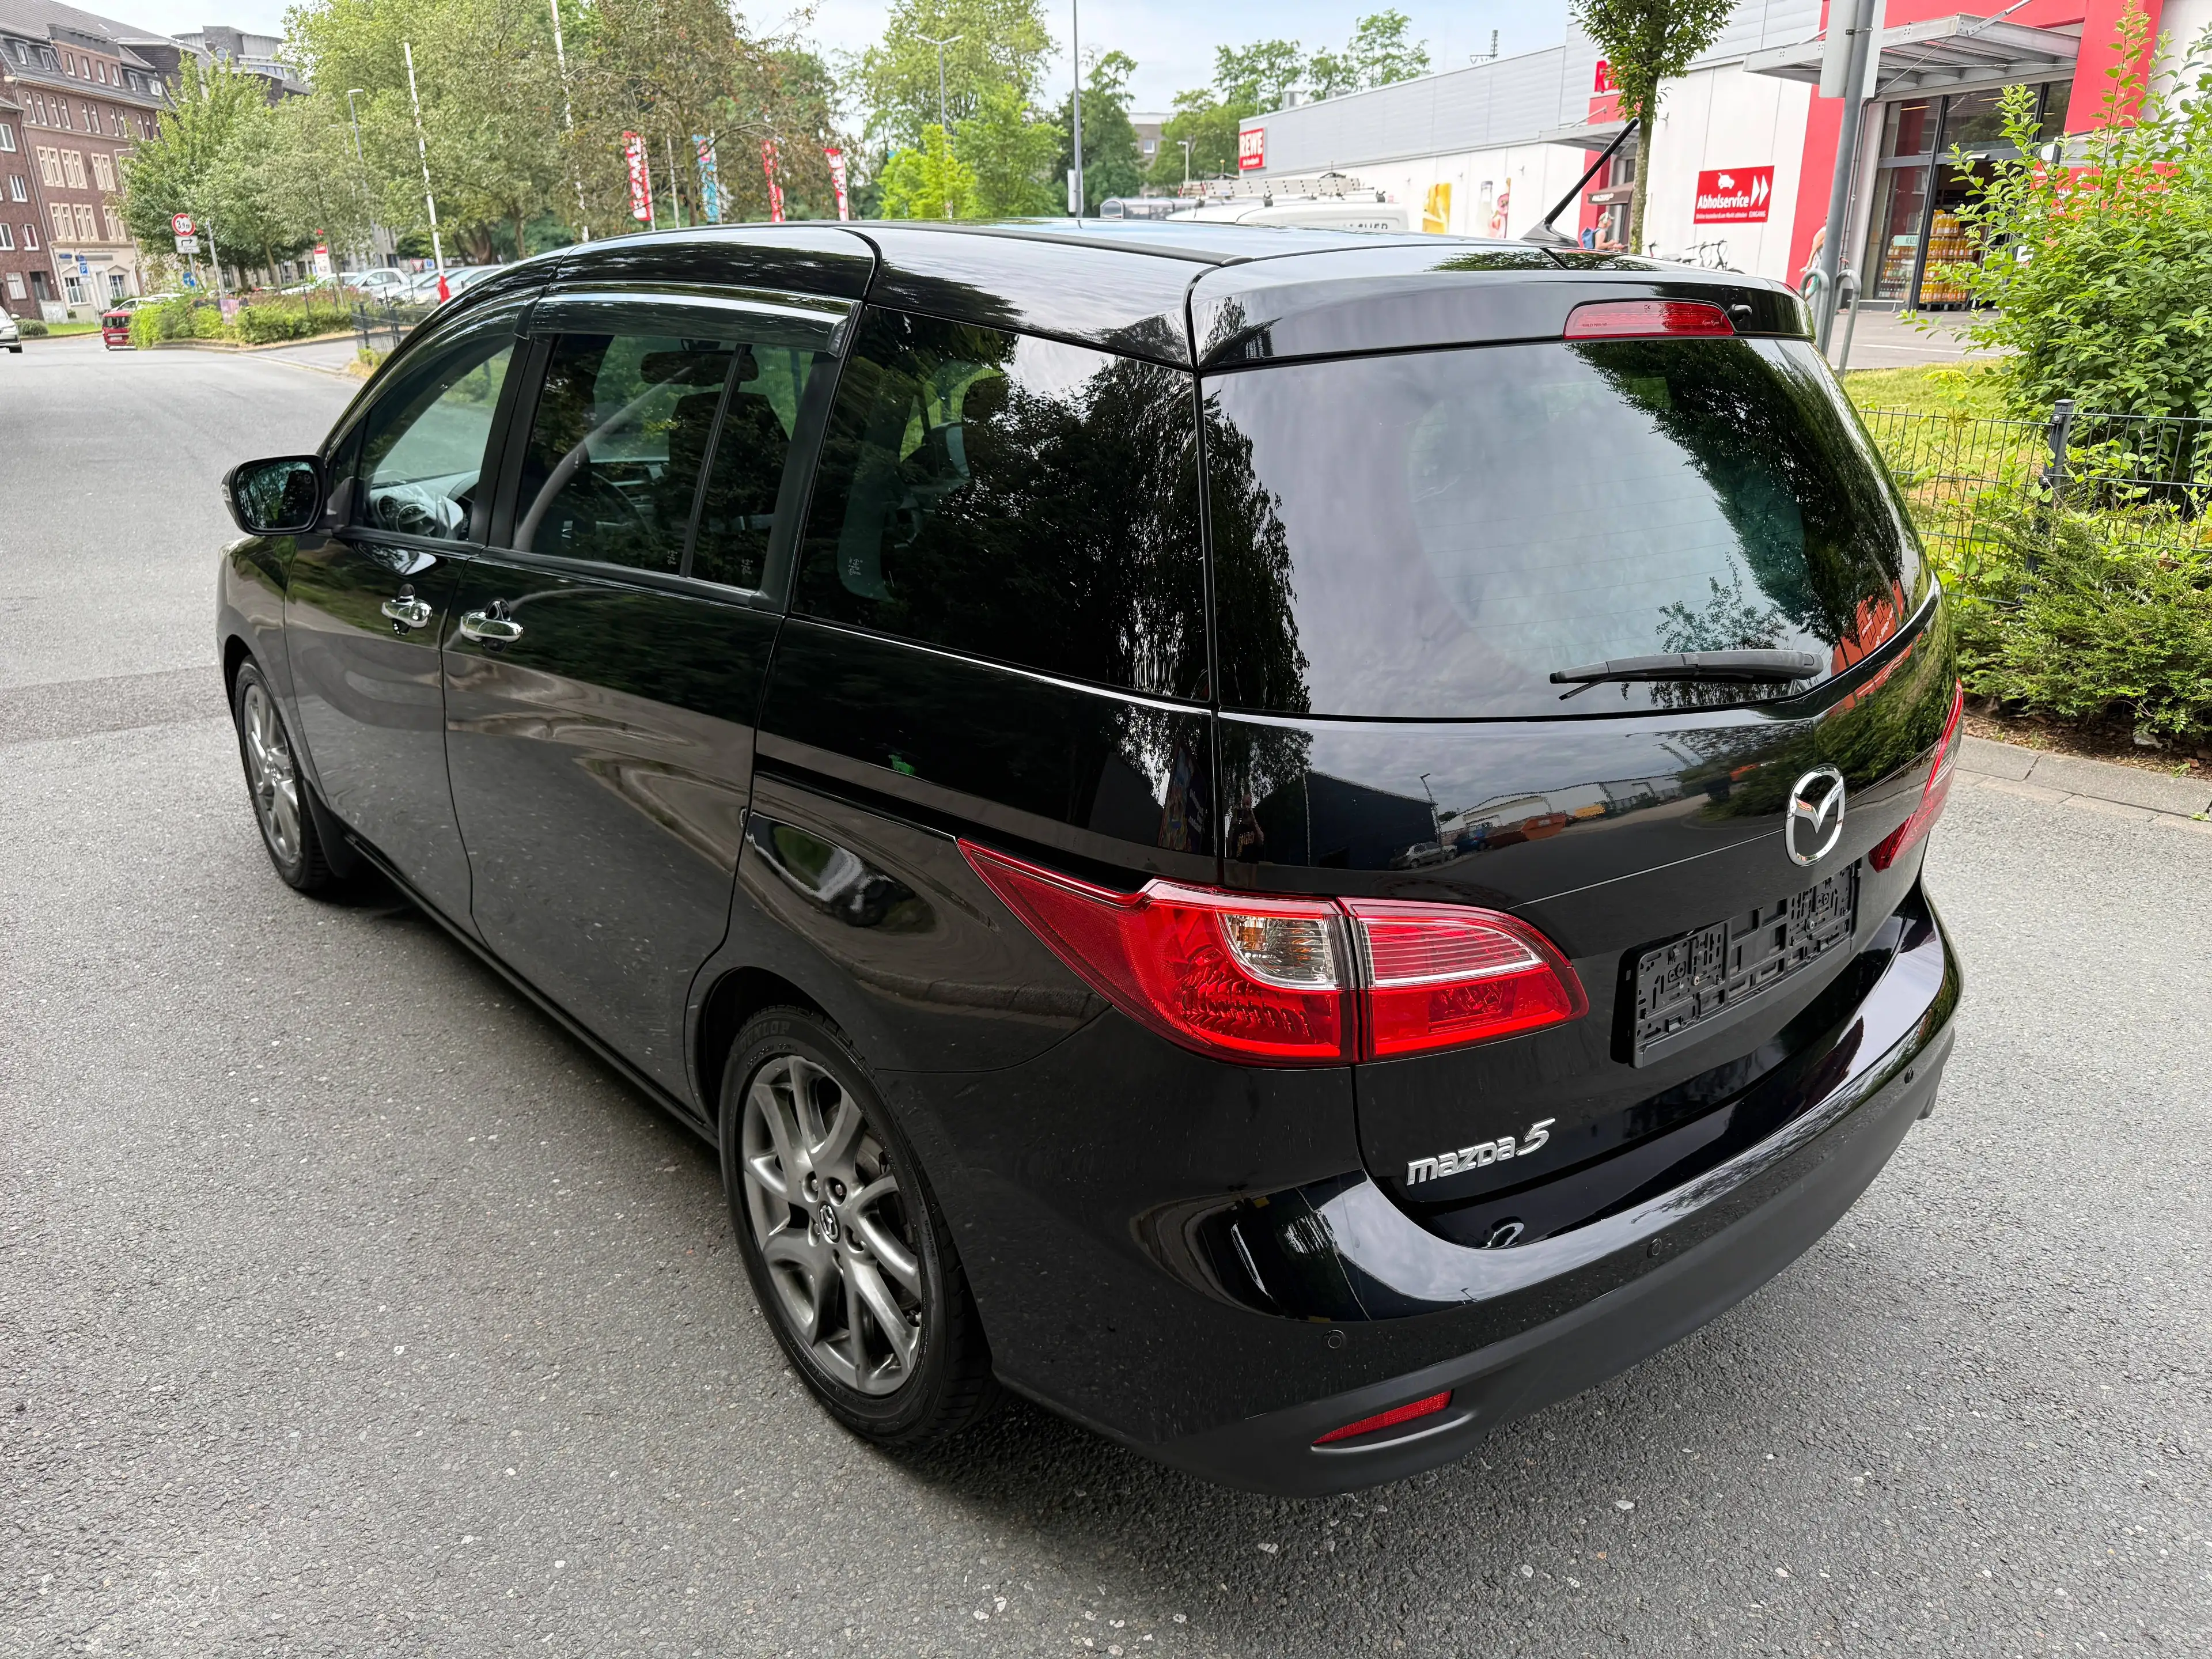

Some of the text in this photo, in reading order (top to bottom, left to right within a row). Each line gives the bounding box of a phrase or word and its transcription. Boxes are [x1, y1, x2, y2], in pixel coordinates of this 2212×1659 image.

[1240, 131, 1263, 157] REWE
[1696, 191, 1749, 209] Abholservice
[740, 1020, 791, 1051] DUNLOP
